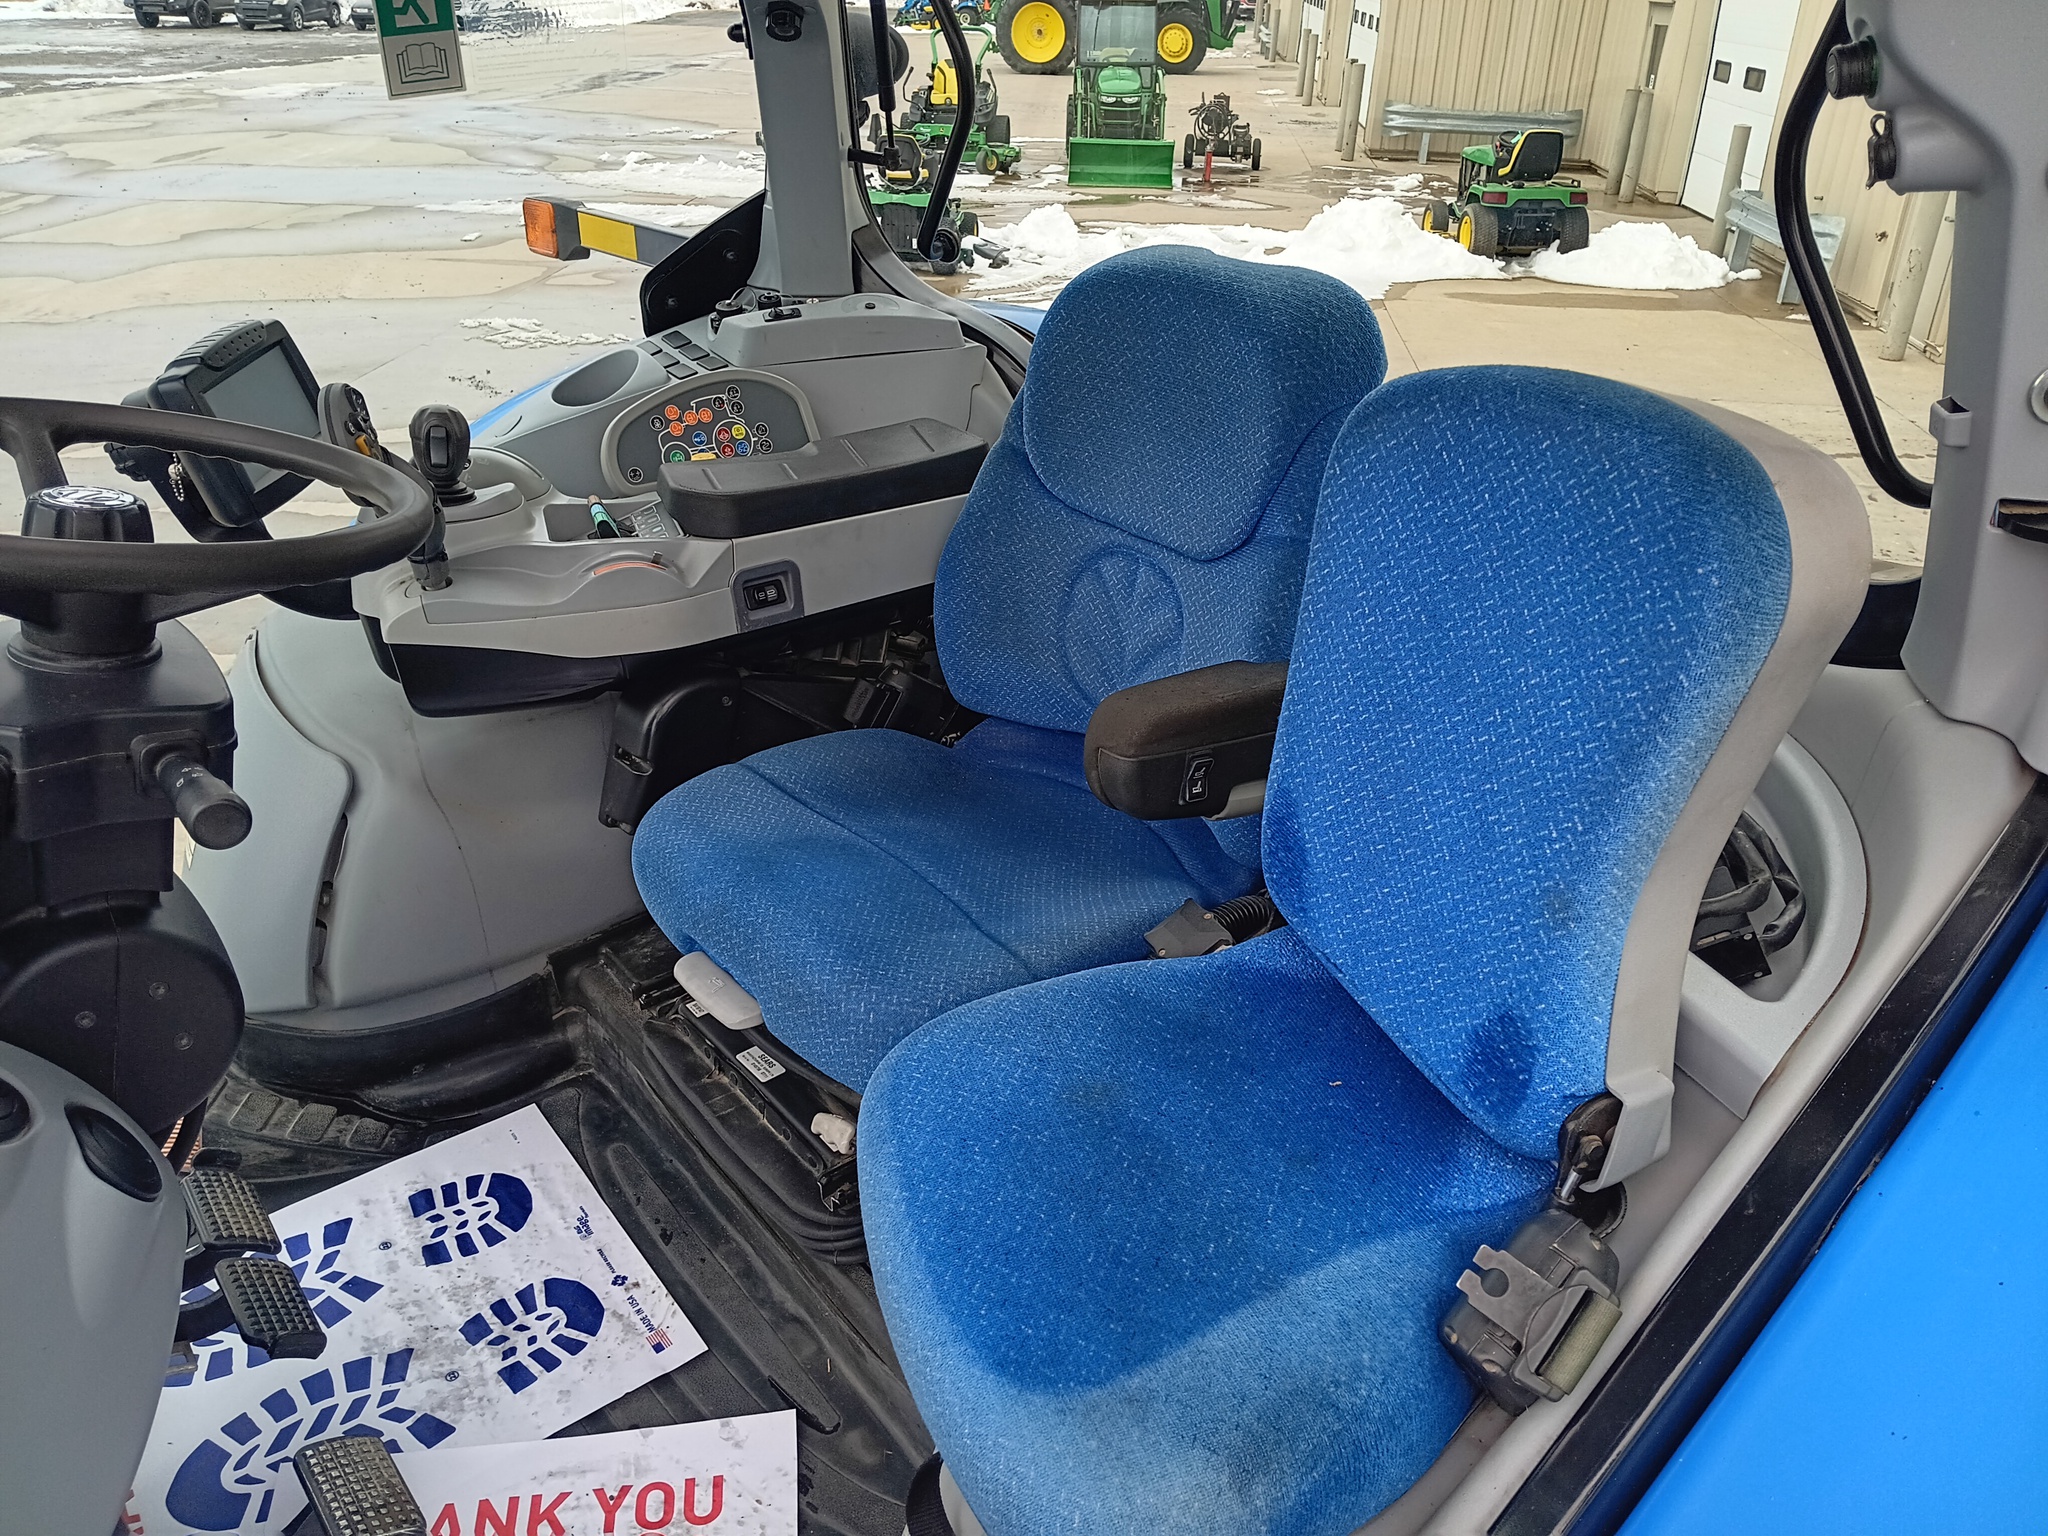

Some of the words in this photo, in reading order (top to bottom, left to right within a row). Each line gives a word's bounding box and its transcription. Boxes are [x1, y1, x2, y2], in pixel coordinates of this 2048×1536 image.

[758, 1054, 776, 1068] SEARS
[627, 1295, 639, 1309] USA
[635, 1307, 644, 1316] IN
[640, 1314, 656, 1333] MADE
[430, 1491, 573, 1535] ANK
[592, 1474, 724, 1534] YOU
